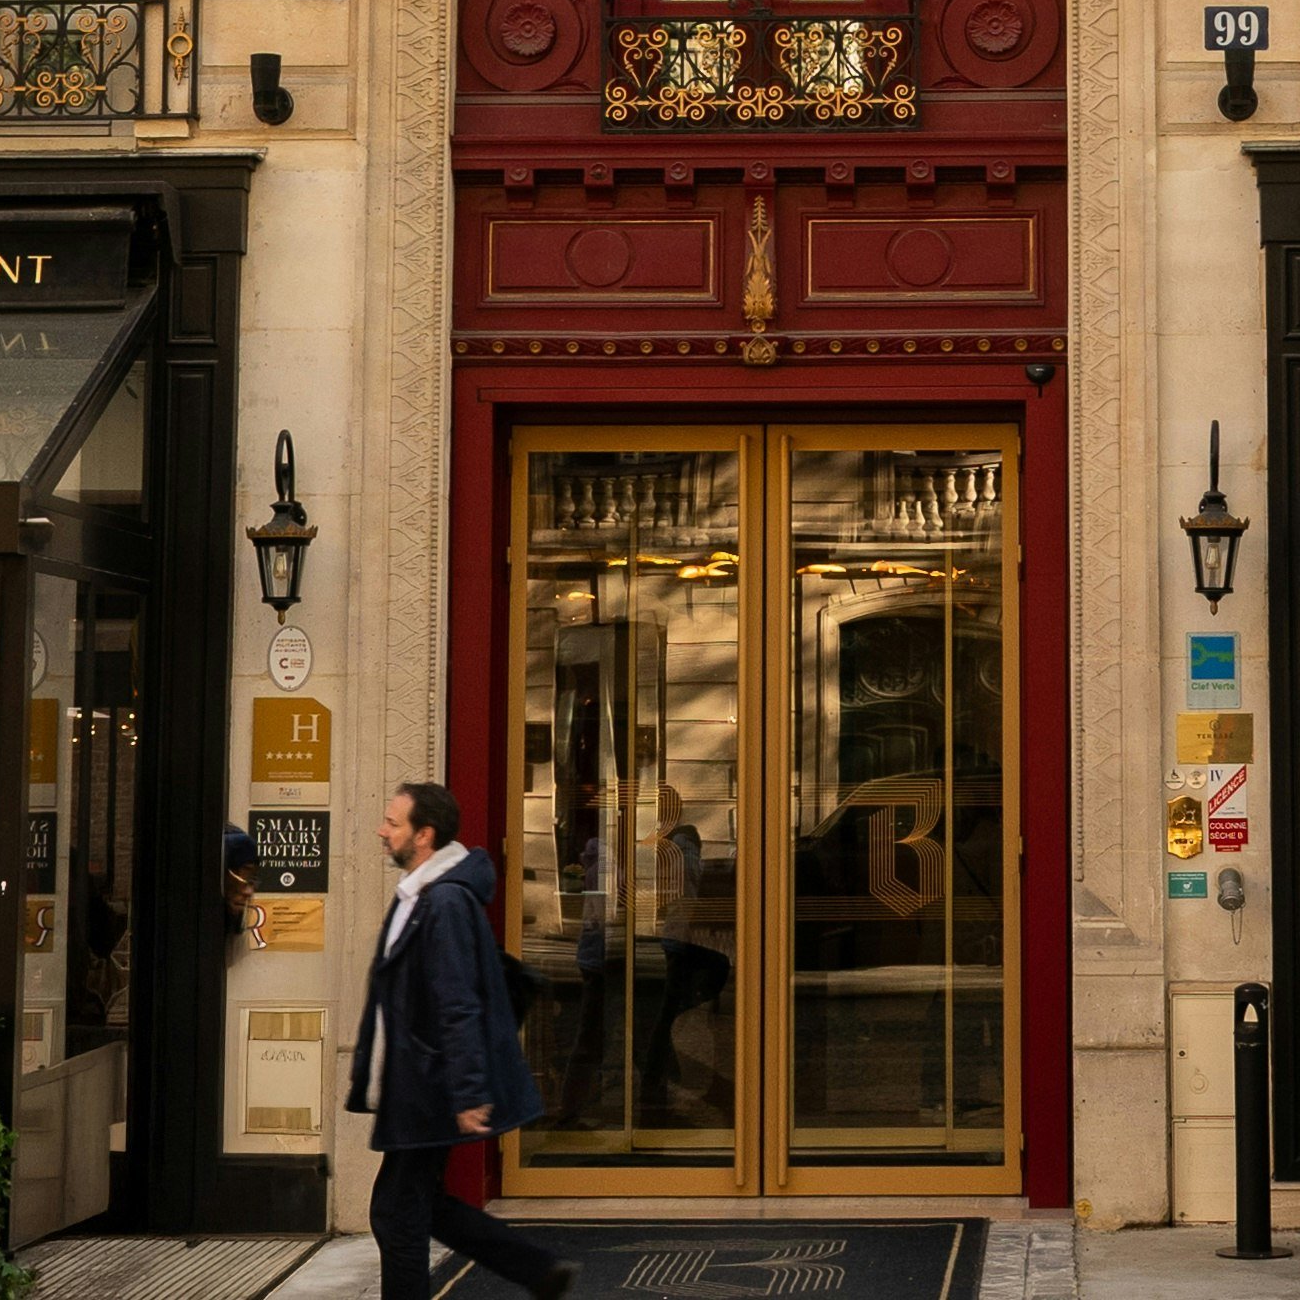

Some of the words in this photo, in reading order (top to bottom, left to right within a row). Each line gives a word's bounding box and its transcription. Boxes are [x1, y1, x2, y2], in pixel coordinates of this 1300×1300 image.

[1214, 11, 1259, 46] 99
[1191, 682, 1209, 690] Clef
[1211, 682, 1235, 690] Verte
[290, 713, 321, 743] H
[1210, 769, 1223, 782] IV
[1209, 769, 1246, 813] LICENCE
[256, 818, 322, 831] SMALL
[1209, 822, 1247, 830] COLONNE
[257, 831, 321, 844] LUXURY
[257, 844, 321, 857] HOTELS
[269, 860, 287, 868] THE
[288, 860, 321, 868] WORLD
